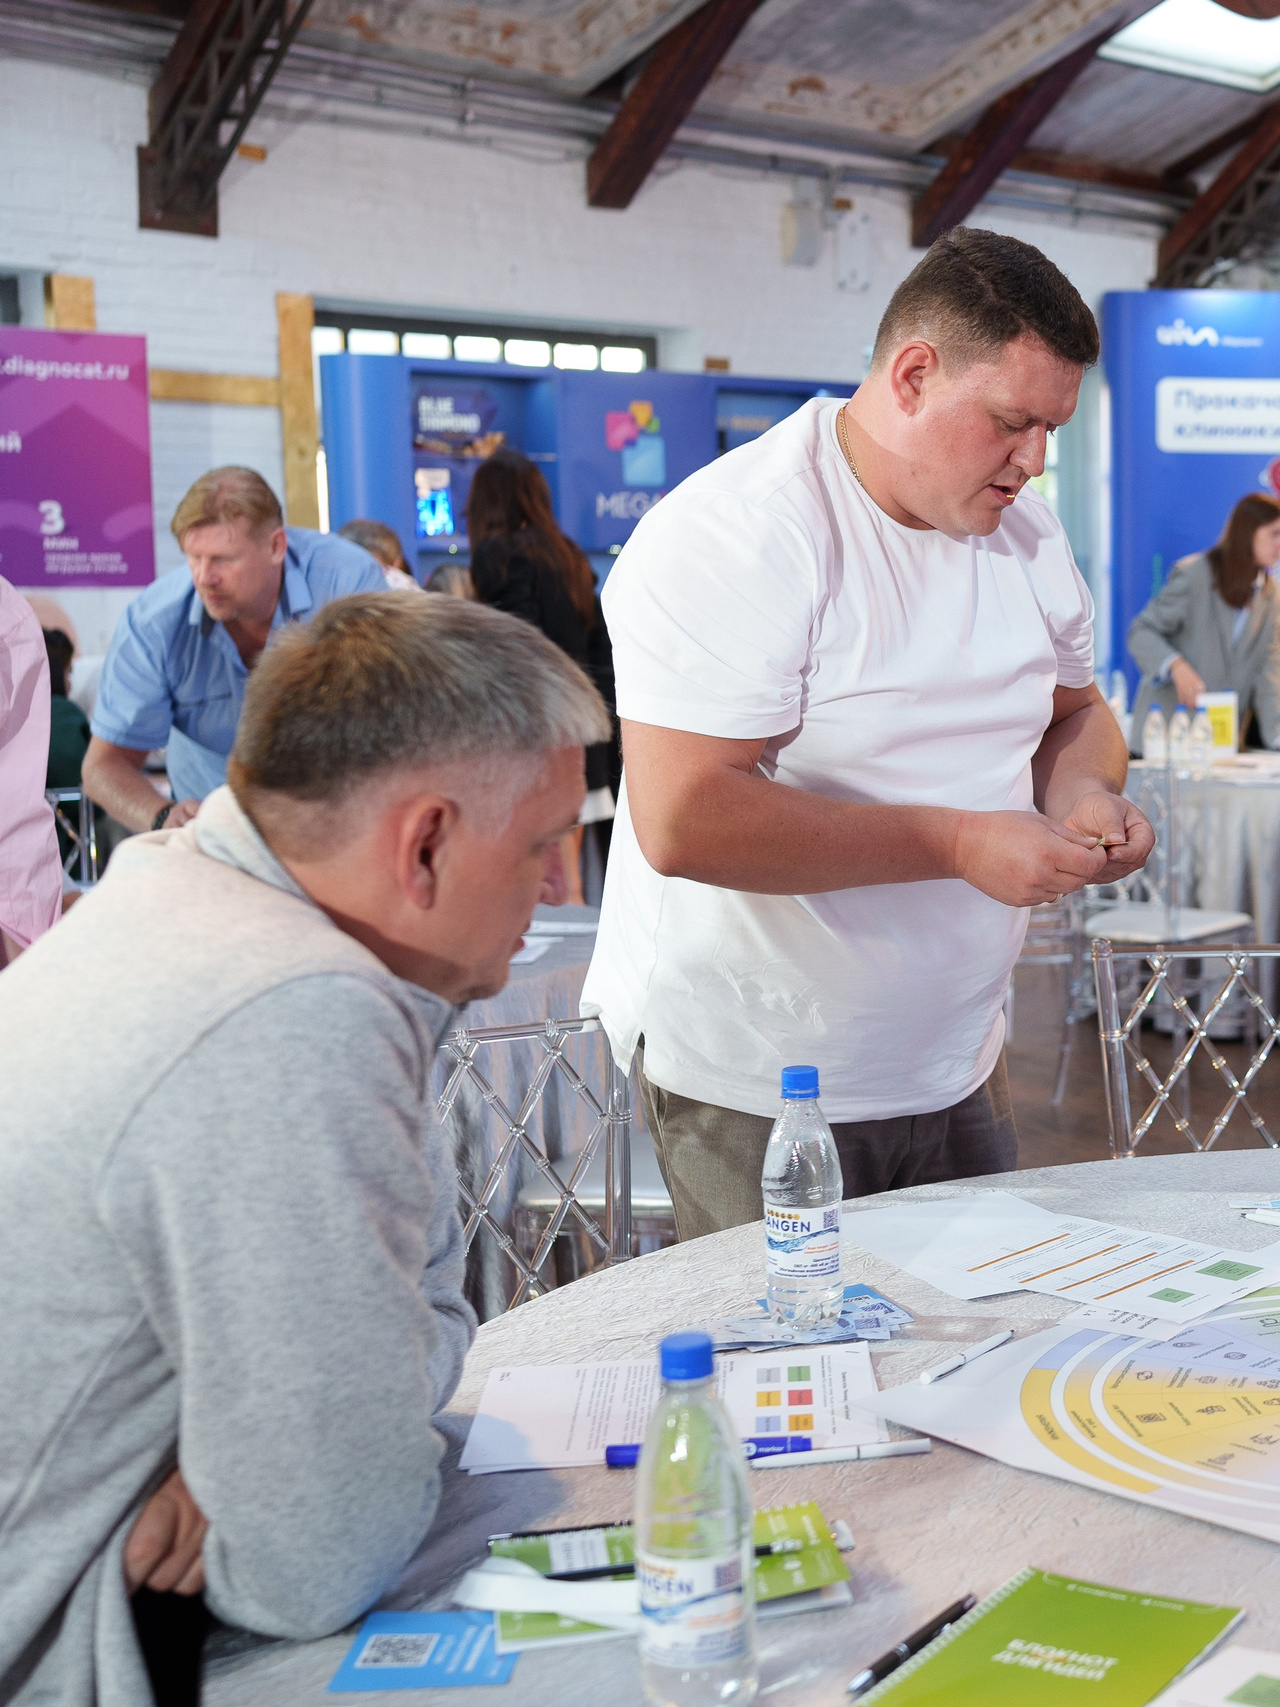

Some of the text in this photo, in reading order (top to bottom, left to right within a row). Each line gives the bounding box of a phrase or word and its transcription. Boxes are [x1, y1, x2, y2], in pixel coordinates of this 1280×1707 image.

[0, 354, 130, 381] .diagnocat.ru
[418, 396, 455, 412] BLUE
[418, 415, 482, 434] DIAMOND
[38, 500, 65, 535] 3
[766, 1216, 811, 1233] ANGEN
[758, 1444, 785, 1456] marker
[639, 1572, 694, 1595] NGEN
[991, 1649, 1042, 1668] ДЛЯ
[1006, 1638, 1119, 1668] БЛОКНОТ
